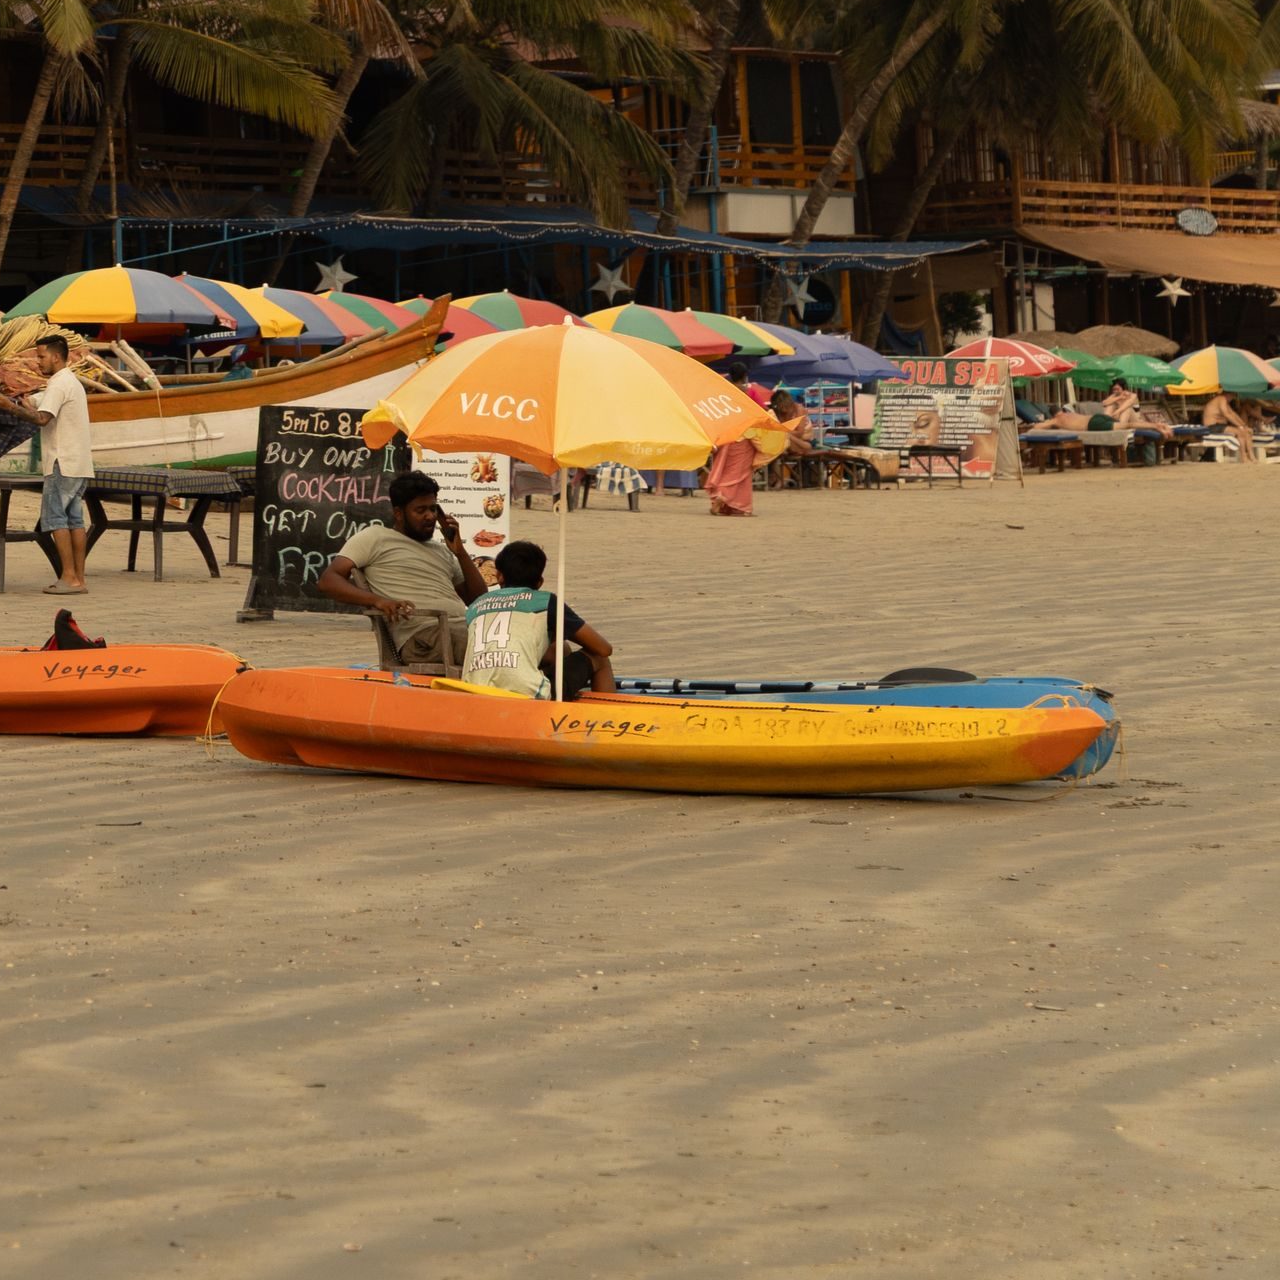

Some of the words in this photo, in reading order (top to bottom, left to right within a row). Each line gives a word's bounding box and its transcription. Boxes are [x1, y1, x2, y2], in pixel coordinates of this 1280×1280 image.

[955, 361, 1000, 386] SPA
[459, 391, 539, 423] VLCC
[692, 394, 743, 422] VLCC
[263, 441, 315, 469] BUY
[322, 445, 372, 470] ONE
[281, 472, 392, 505] COCKTAIL
[262, 504, 317, 538] GET
[473, 610, 513, 654] 14
[43, 662, 147, 680] Voyager
[550, 714, 661, 737] Voyager
